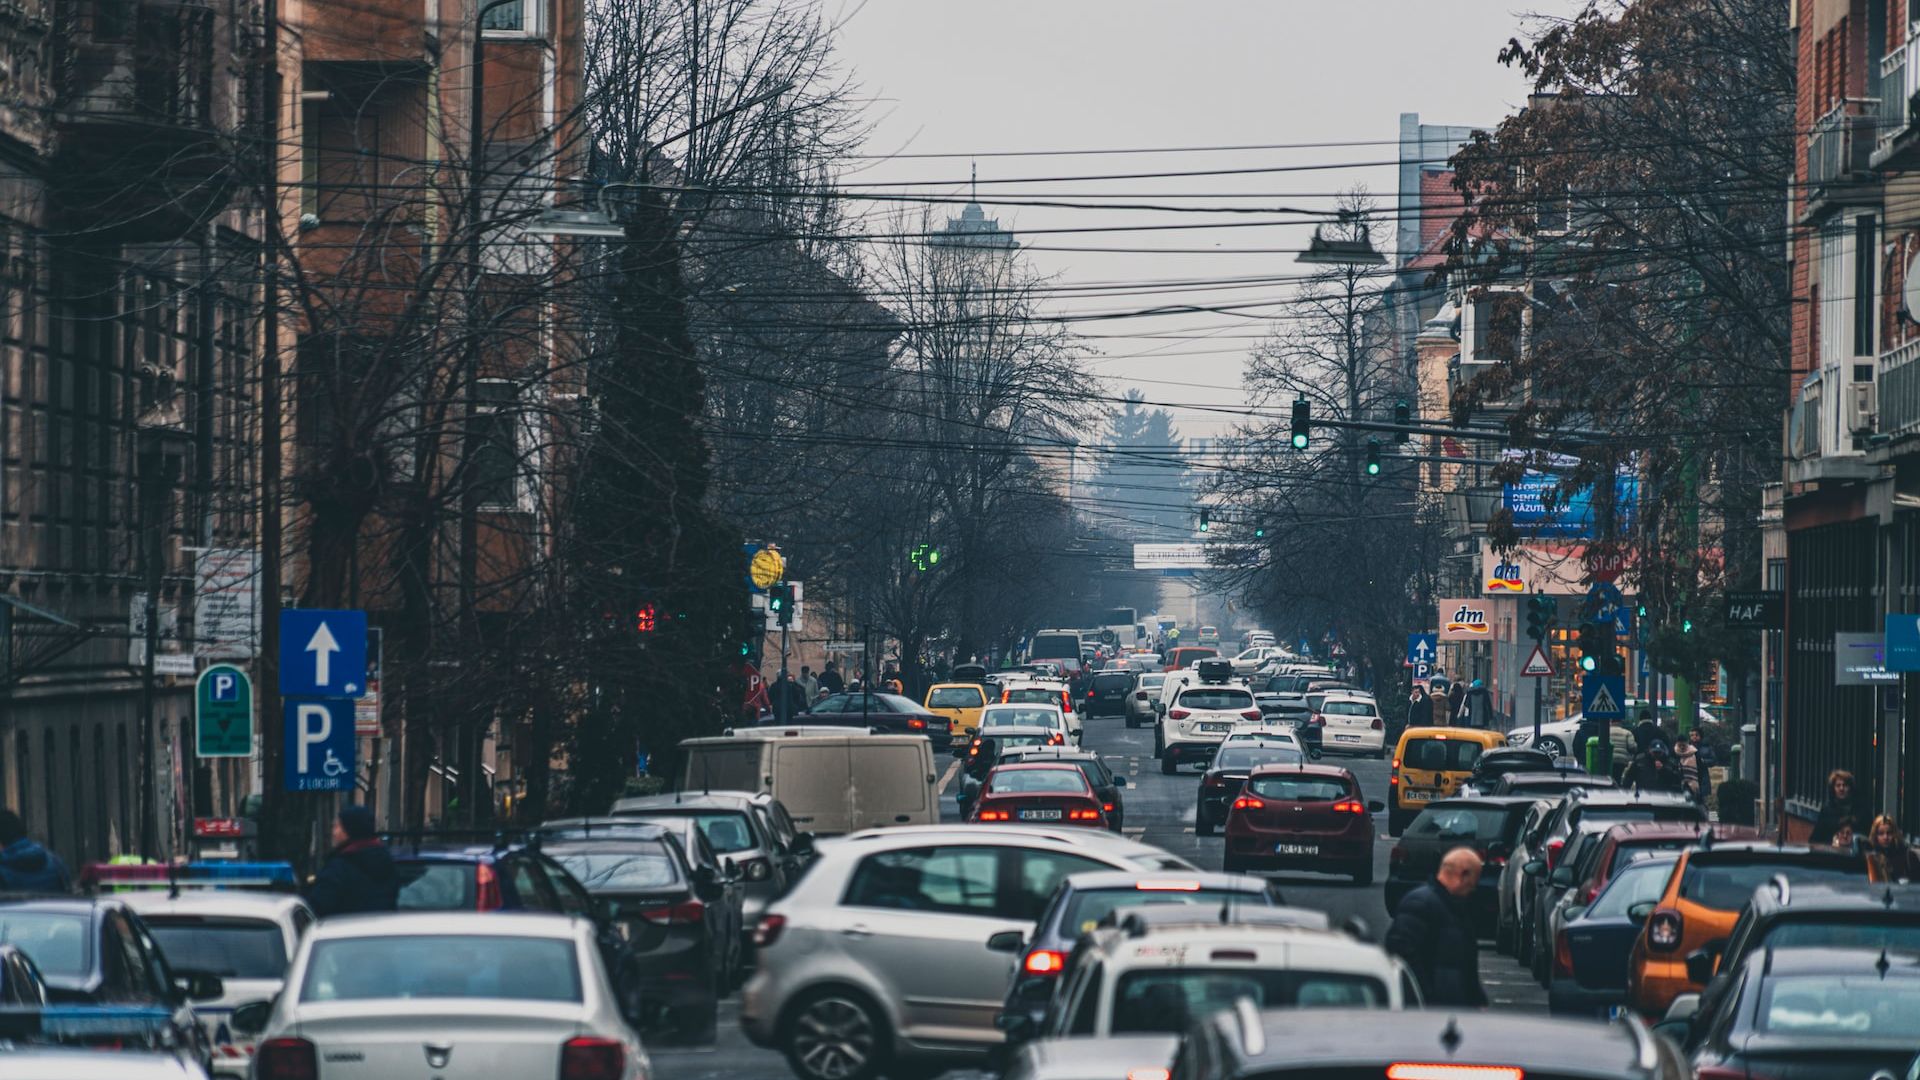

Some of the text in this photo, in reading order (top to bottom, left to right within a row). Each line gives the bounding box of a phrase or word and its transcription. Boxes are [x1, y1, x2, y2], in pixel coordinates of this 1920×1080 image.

[1494, 558, 1521, 579] dm
[1455, 606, 1484, 623] dm
[1729, 603, 1764, 621] HAF
[1418, 665, 1428, 677] P
[216, 677, 233, 699] P
[297, 704, 332, 774] P
[299, 778, 305, 790] 2
